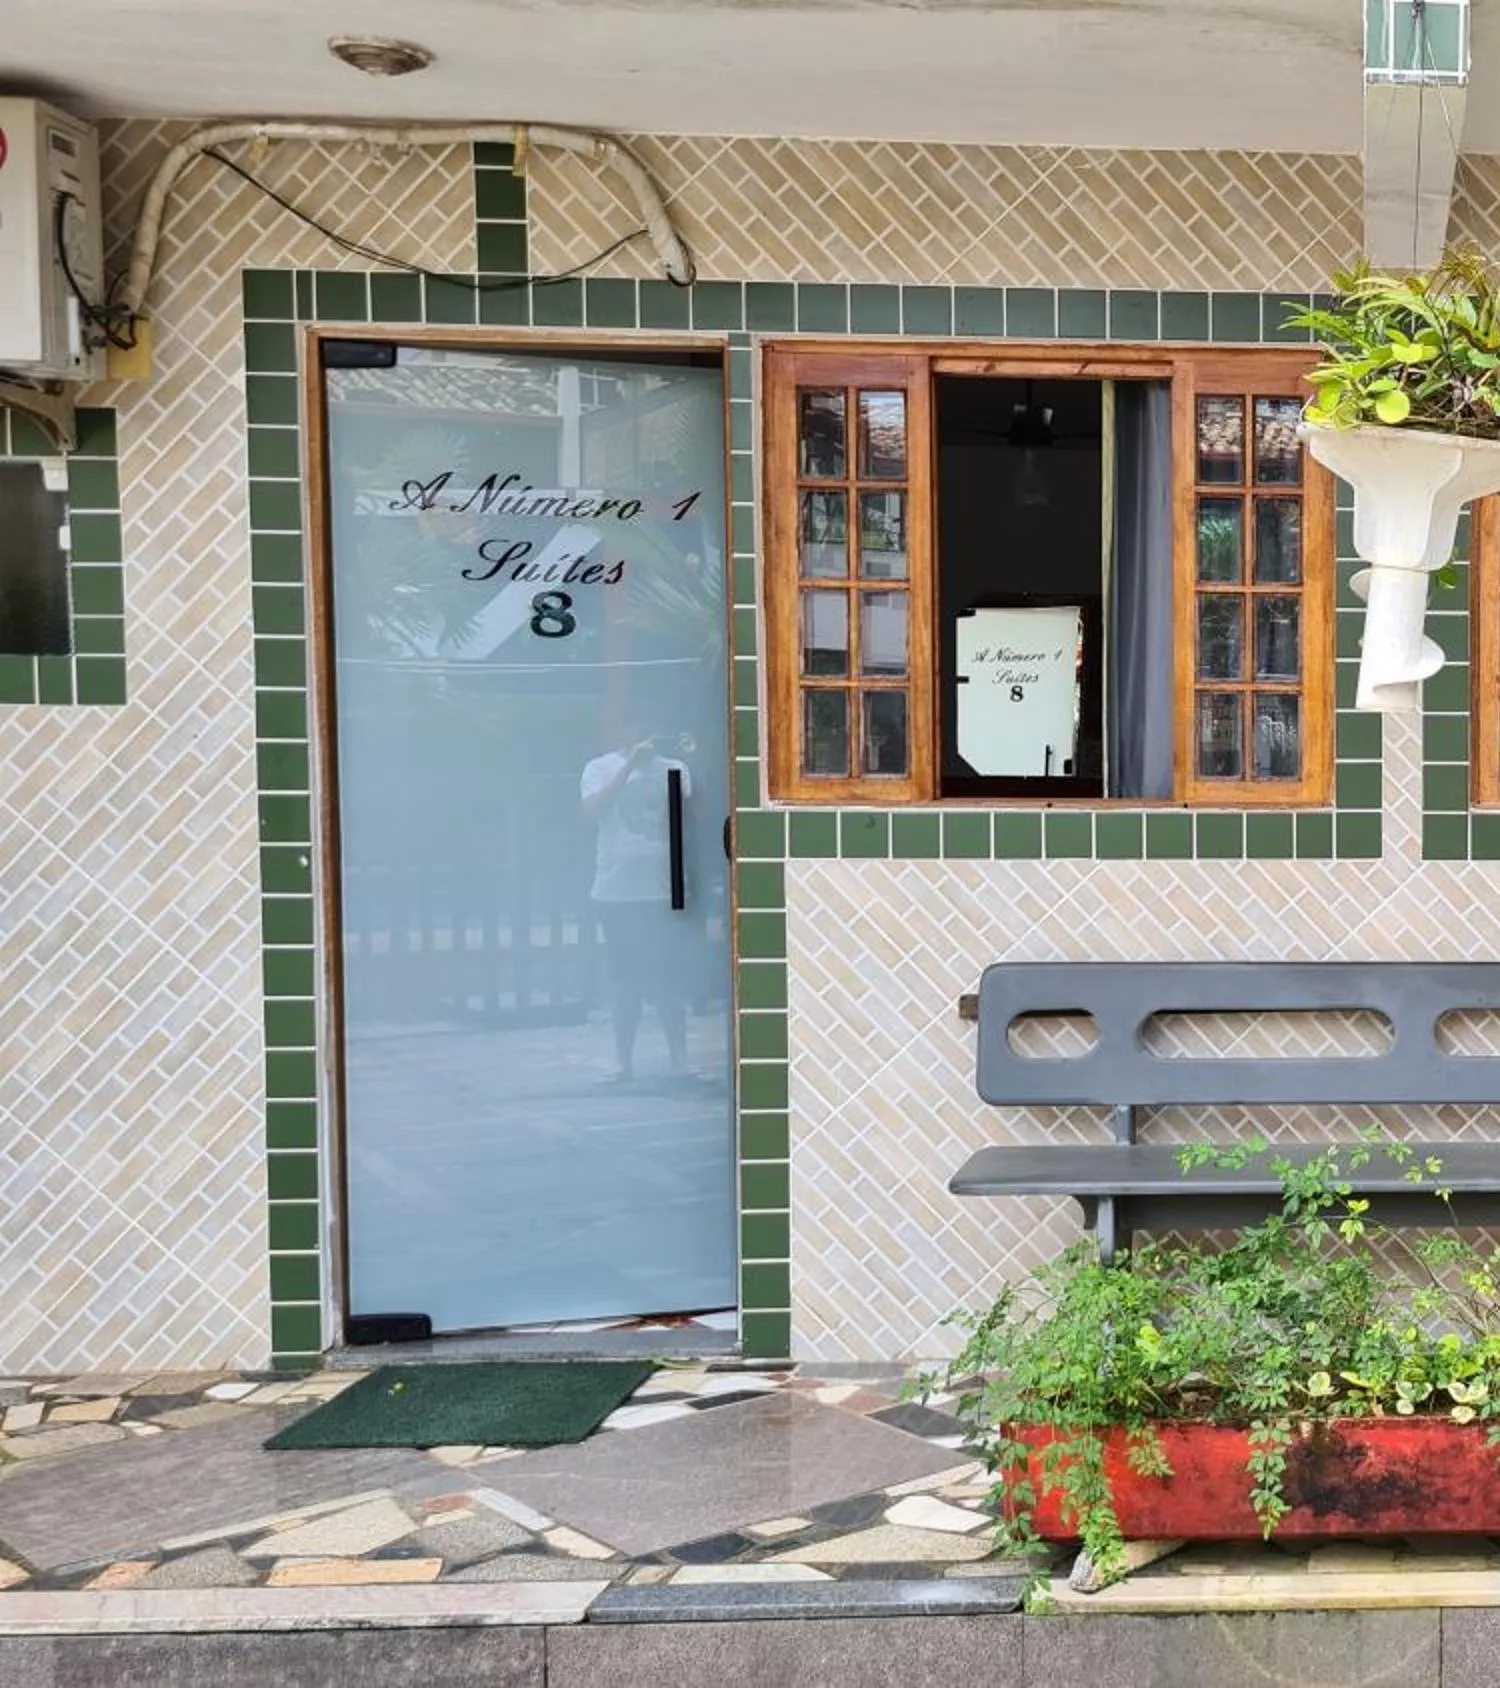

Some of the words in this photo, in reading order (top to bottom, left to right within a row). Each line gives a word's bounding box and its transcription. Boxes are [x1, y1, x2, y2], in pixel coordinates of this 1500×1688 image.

[389, 471, 453, 511] A
[450, 473, 644, 520] Número
[671, 491, 702, 521] 1
[528, 591, 577, 638] 8
[1010, 685, 1024, 702] 8
